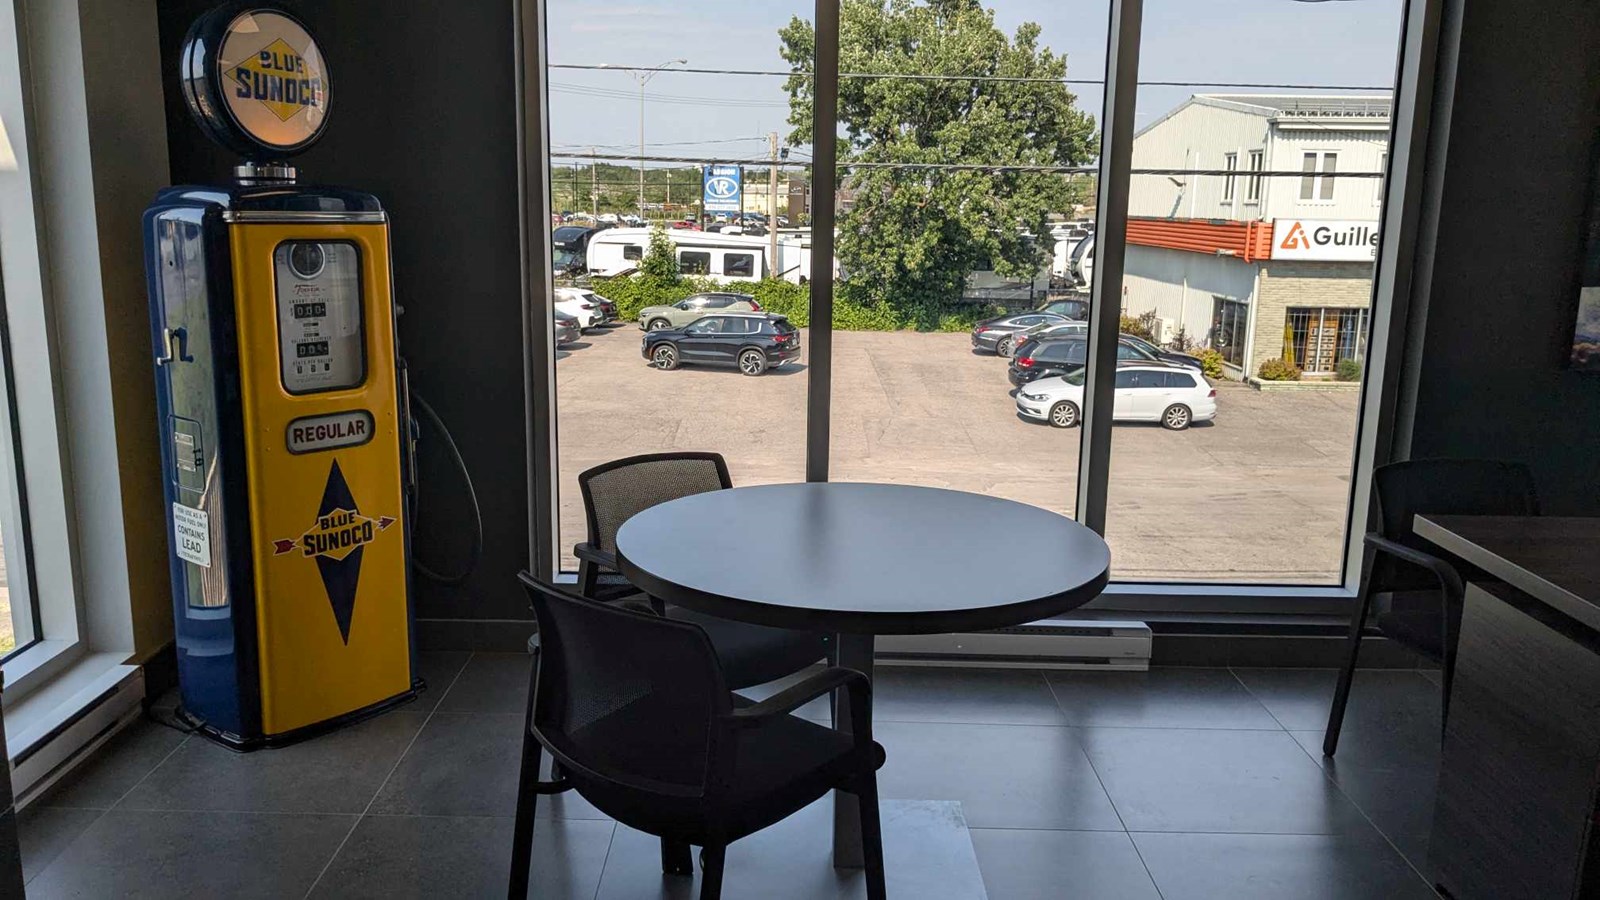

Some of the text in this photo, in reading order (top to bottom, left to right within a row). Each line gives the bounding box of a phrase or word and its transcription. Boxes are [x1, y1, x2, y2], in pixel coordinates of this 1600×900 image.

[260, 51, 303, 73] BLUE
[712, 180, 729, 196] VR
[293, 420, 366, 444] REGULAR
[320, 511, 356, 531] BLUE
[178, 524, 205, 541] CONTAINS
[303, 520, 374, 556] SUNOCO
[182, 537, 202, 553] LEAD
